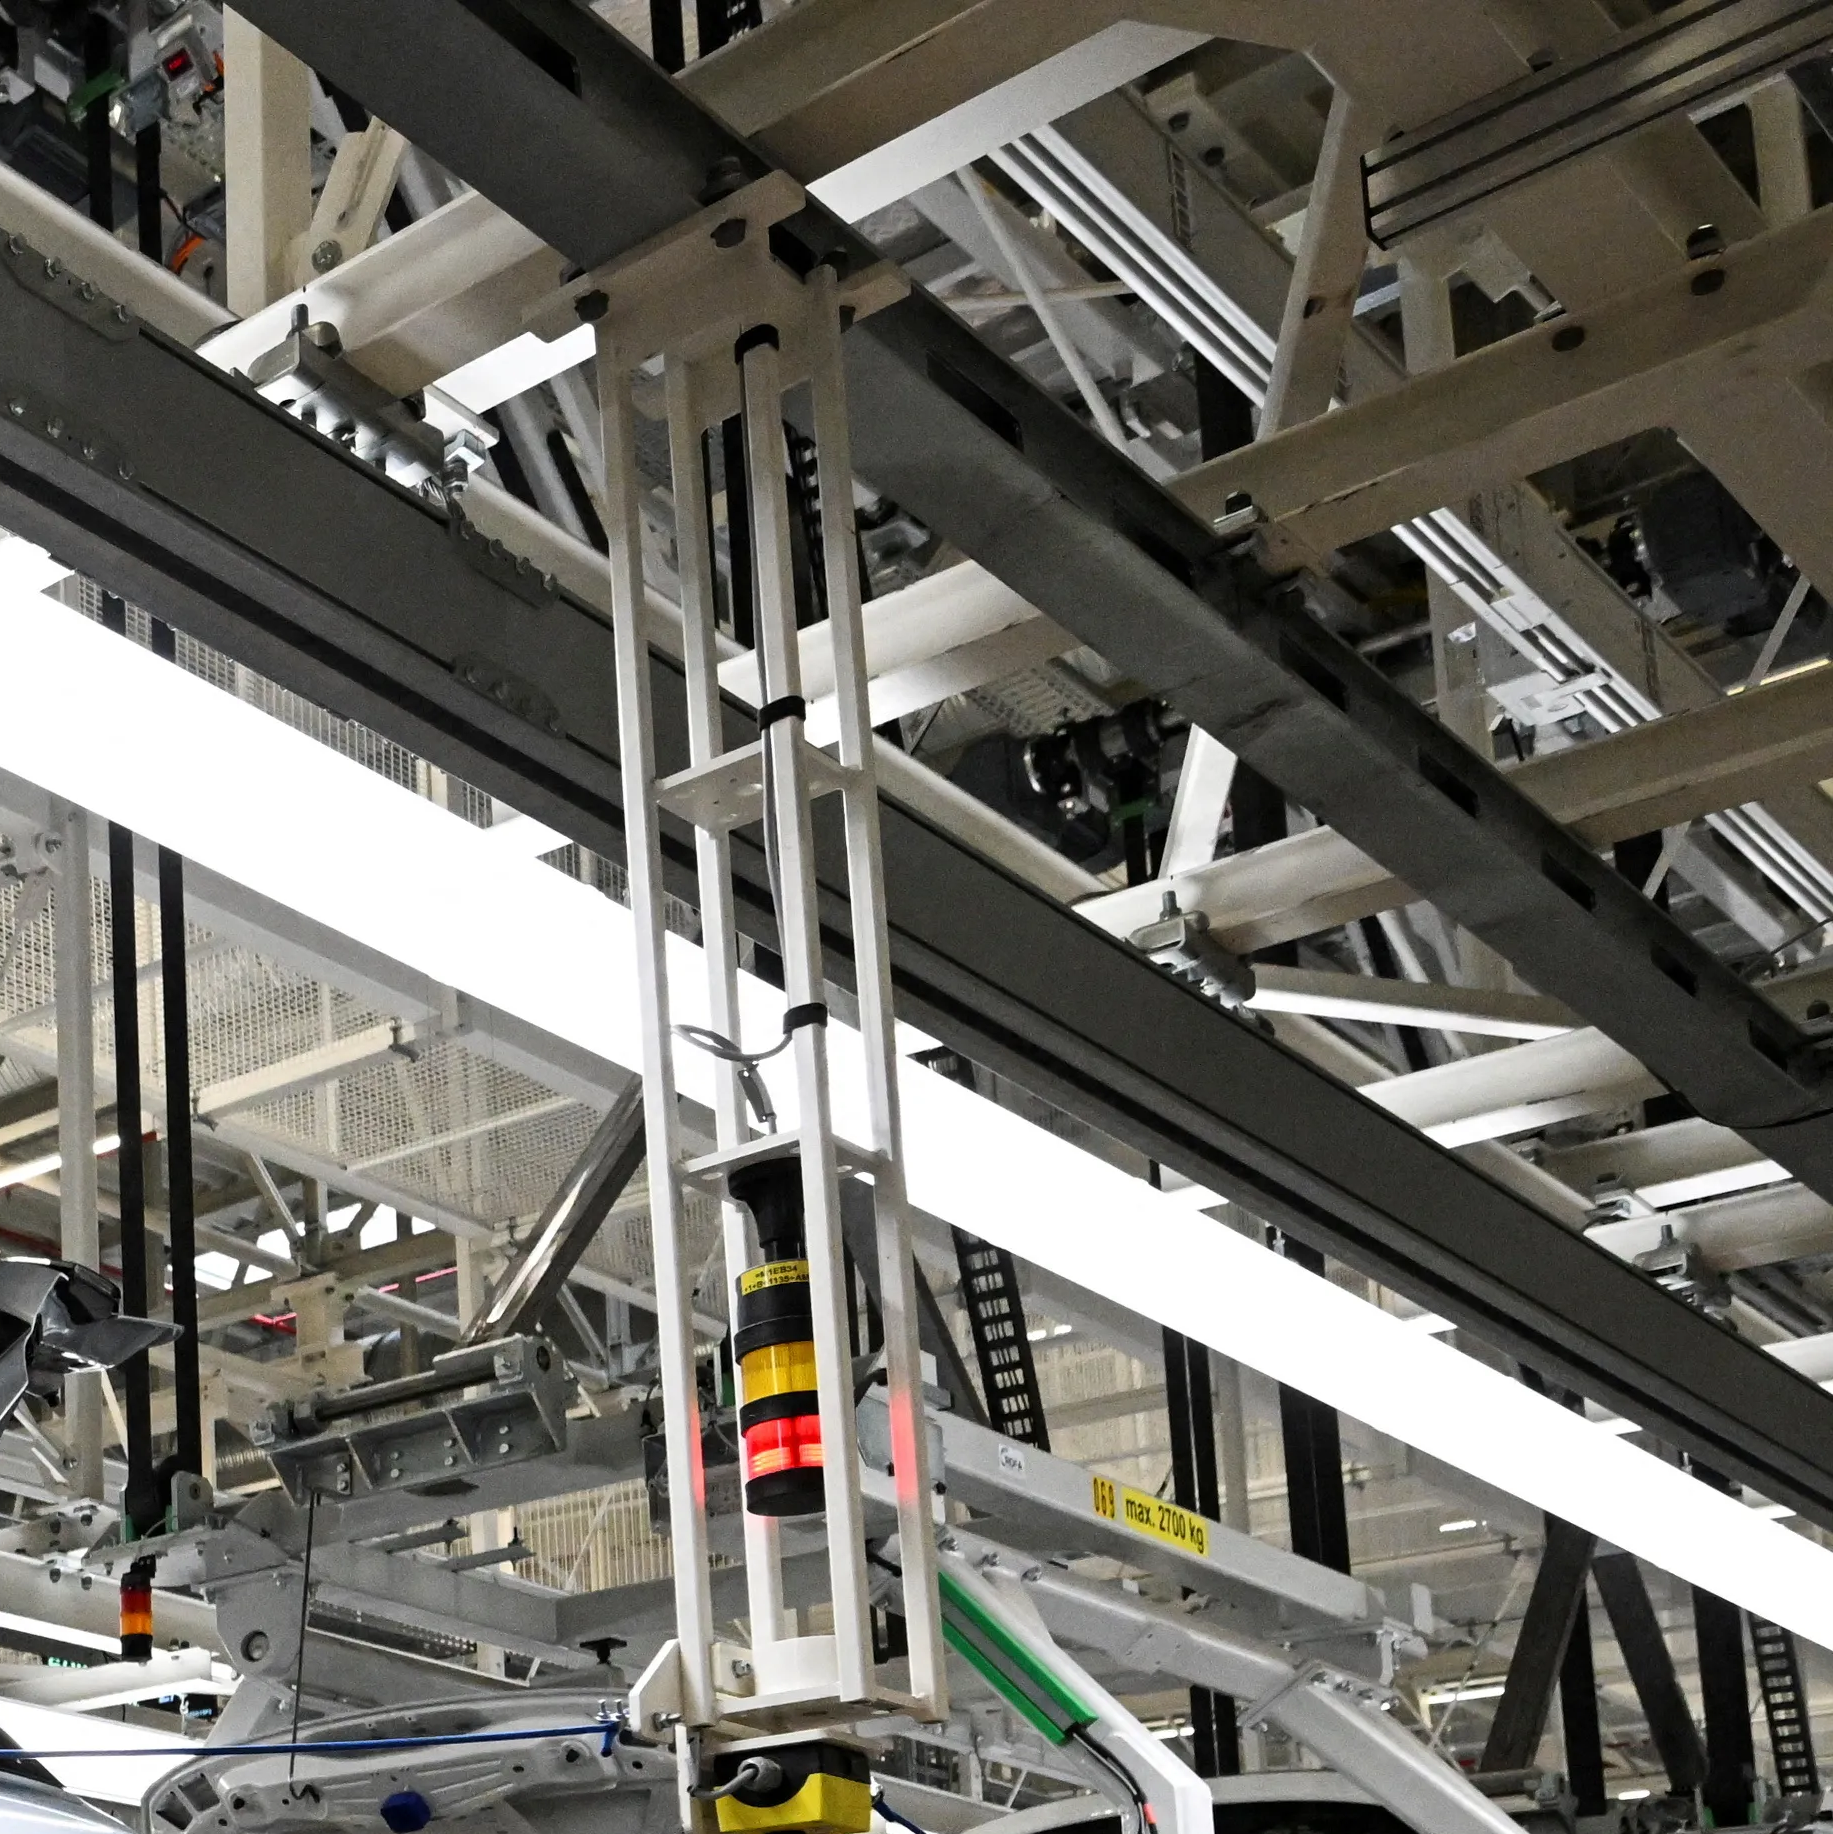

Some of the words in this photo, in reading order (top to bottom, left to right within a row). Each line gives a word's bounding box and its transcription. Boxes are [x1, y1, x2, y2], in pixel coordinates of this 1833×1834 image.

[1092, 1477, 1116, 1520] 069
[1125, 1497, 1156, 1528] max.
[1158, 1504, 1186, 1541] 2700
[1189, 1517, 1205, 1555] kg
